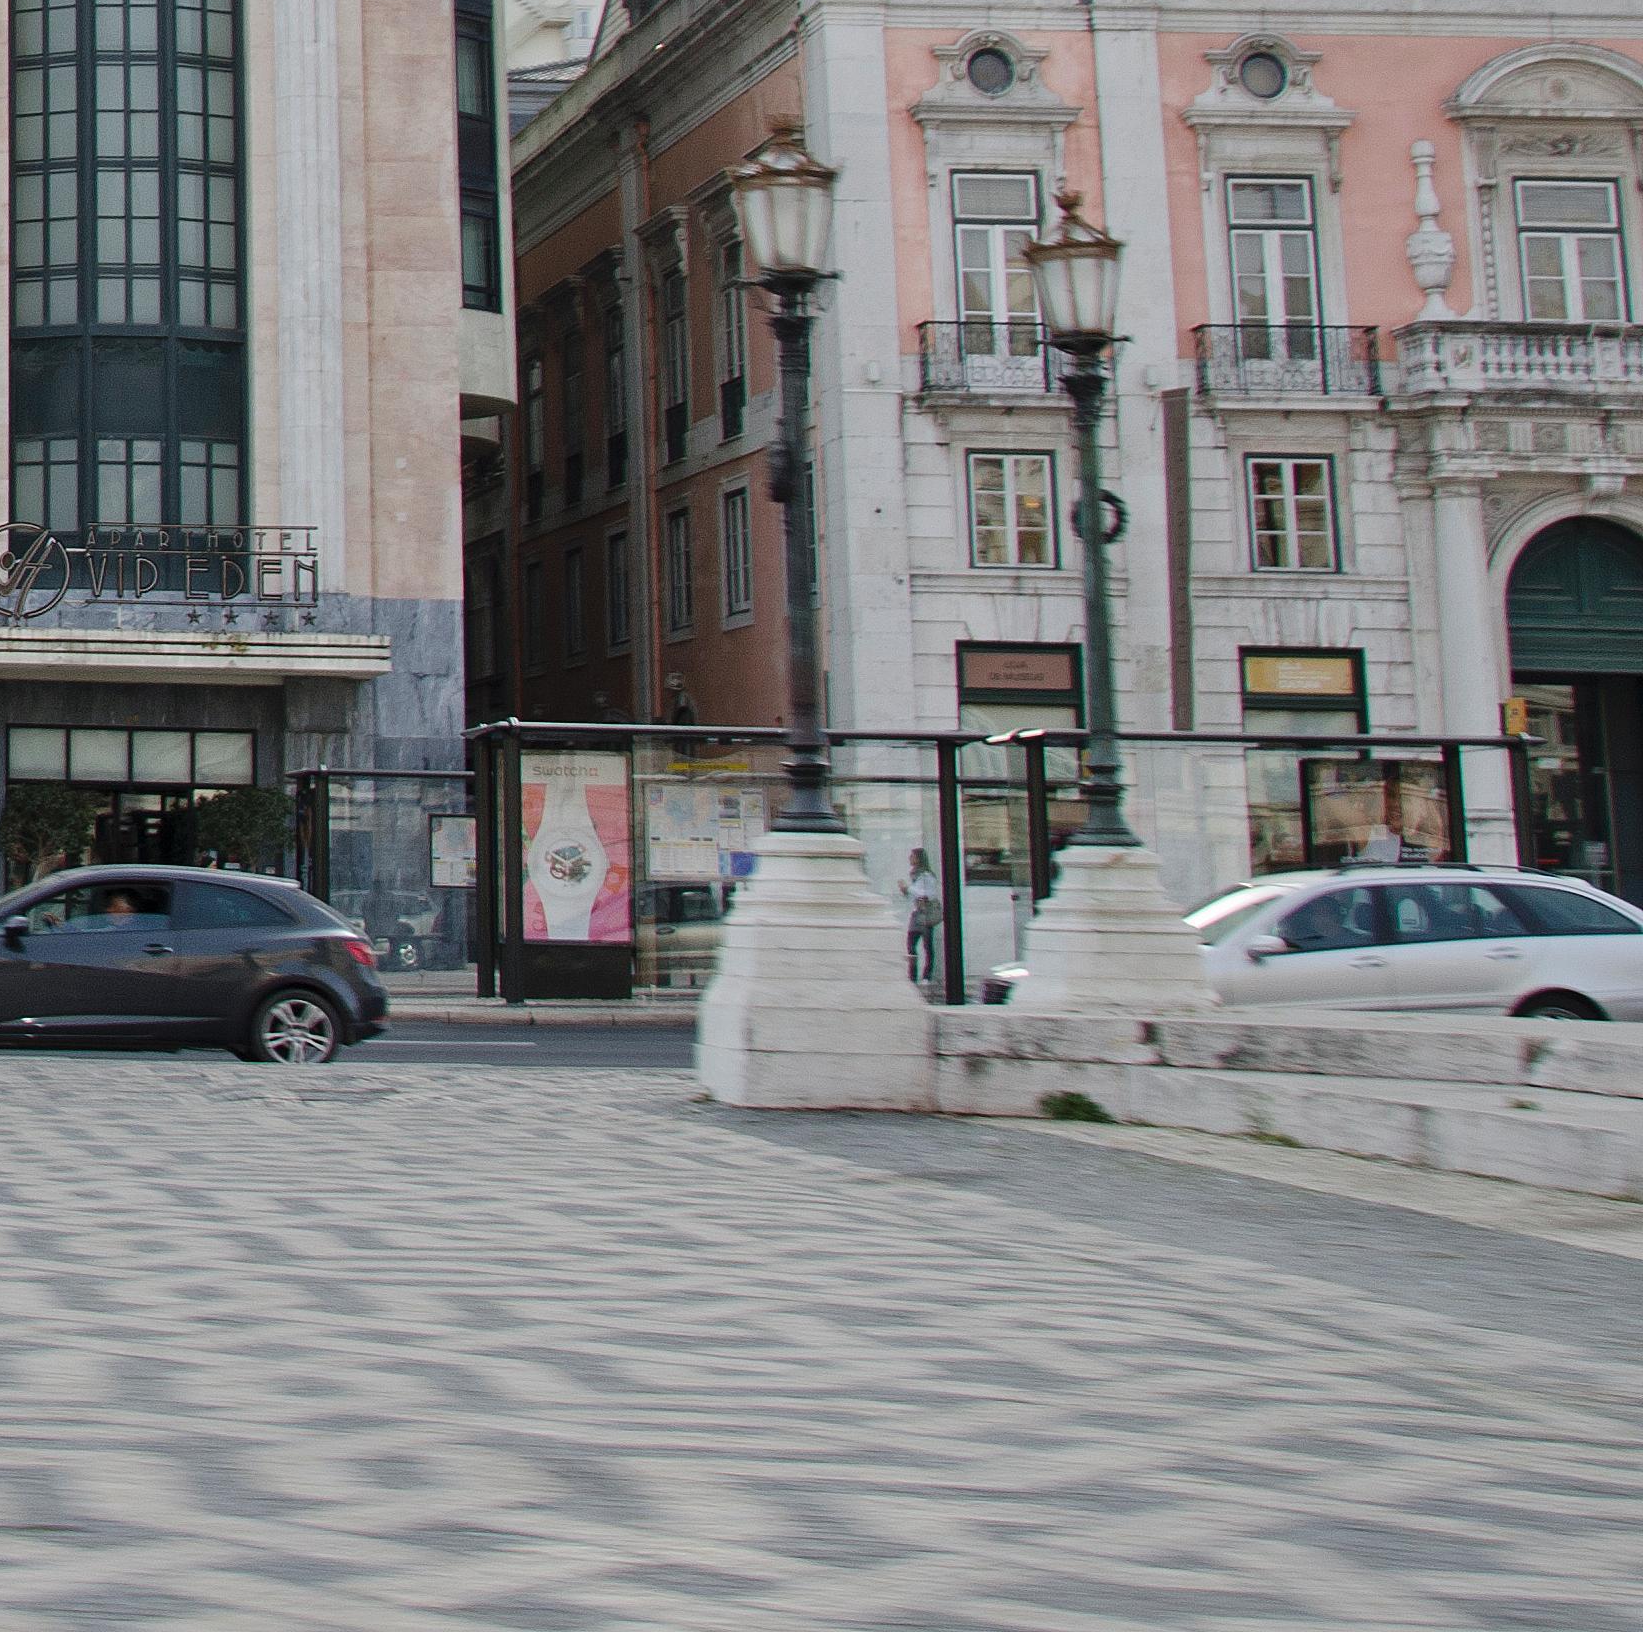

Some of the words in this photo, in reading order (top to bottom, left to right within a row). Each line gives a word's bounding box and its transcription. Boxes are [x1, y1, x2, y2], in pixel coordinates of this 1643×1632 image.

[86, 553, 158, 598] VIP
[186, 555, 318, 601] EDEN
[533, 766, 588, 777] swatch
